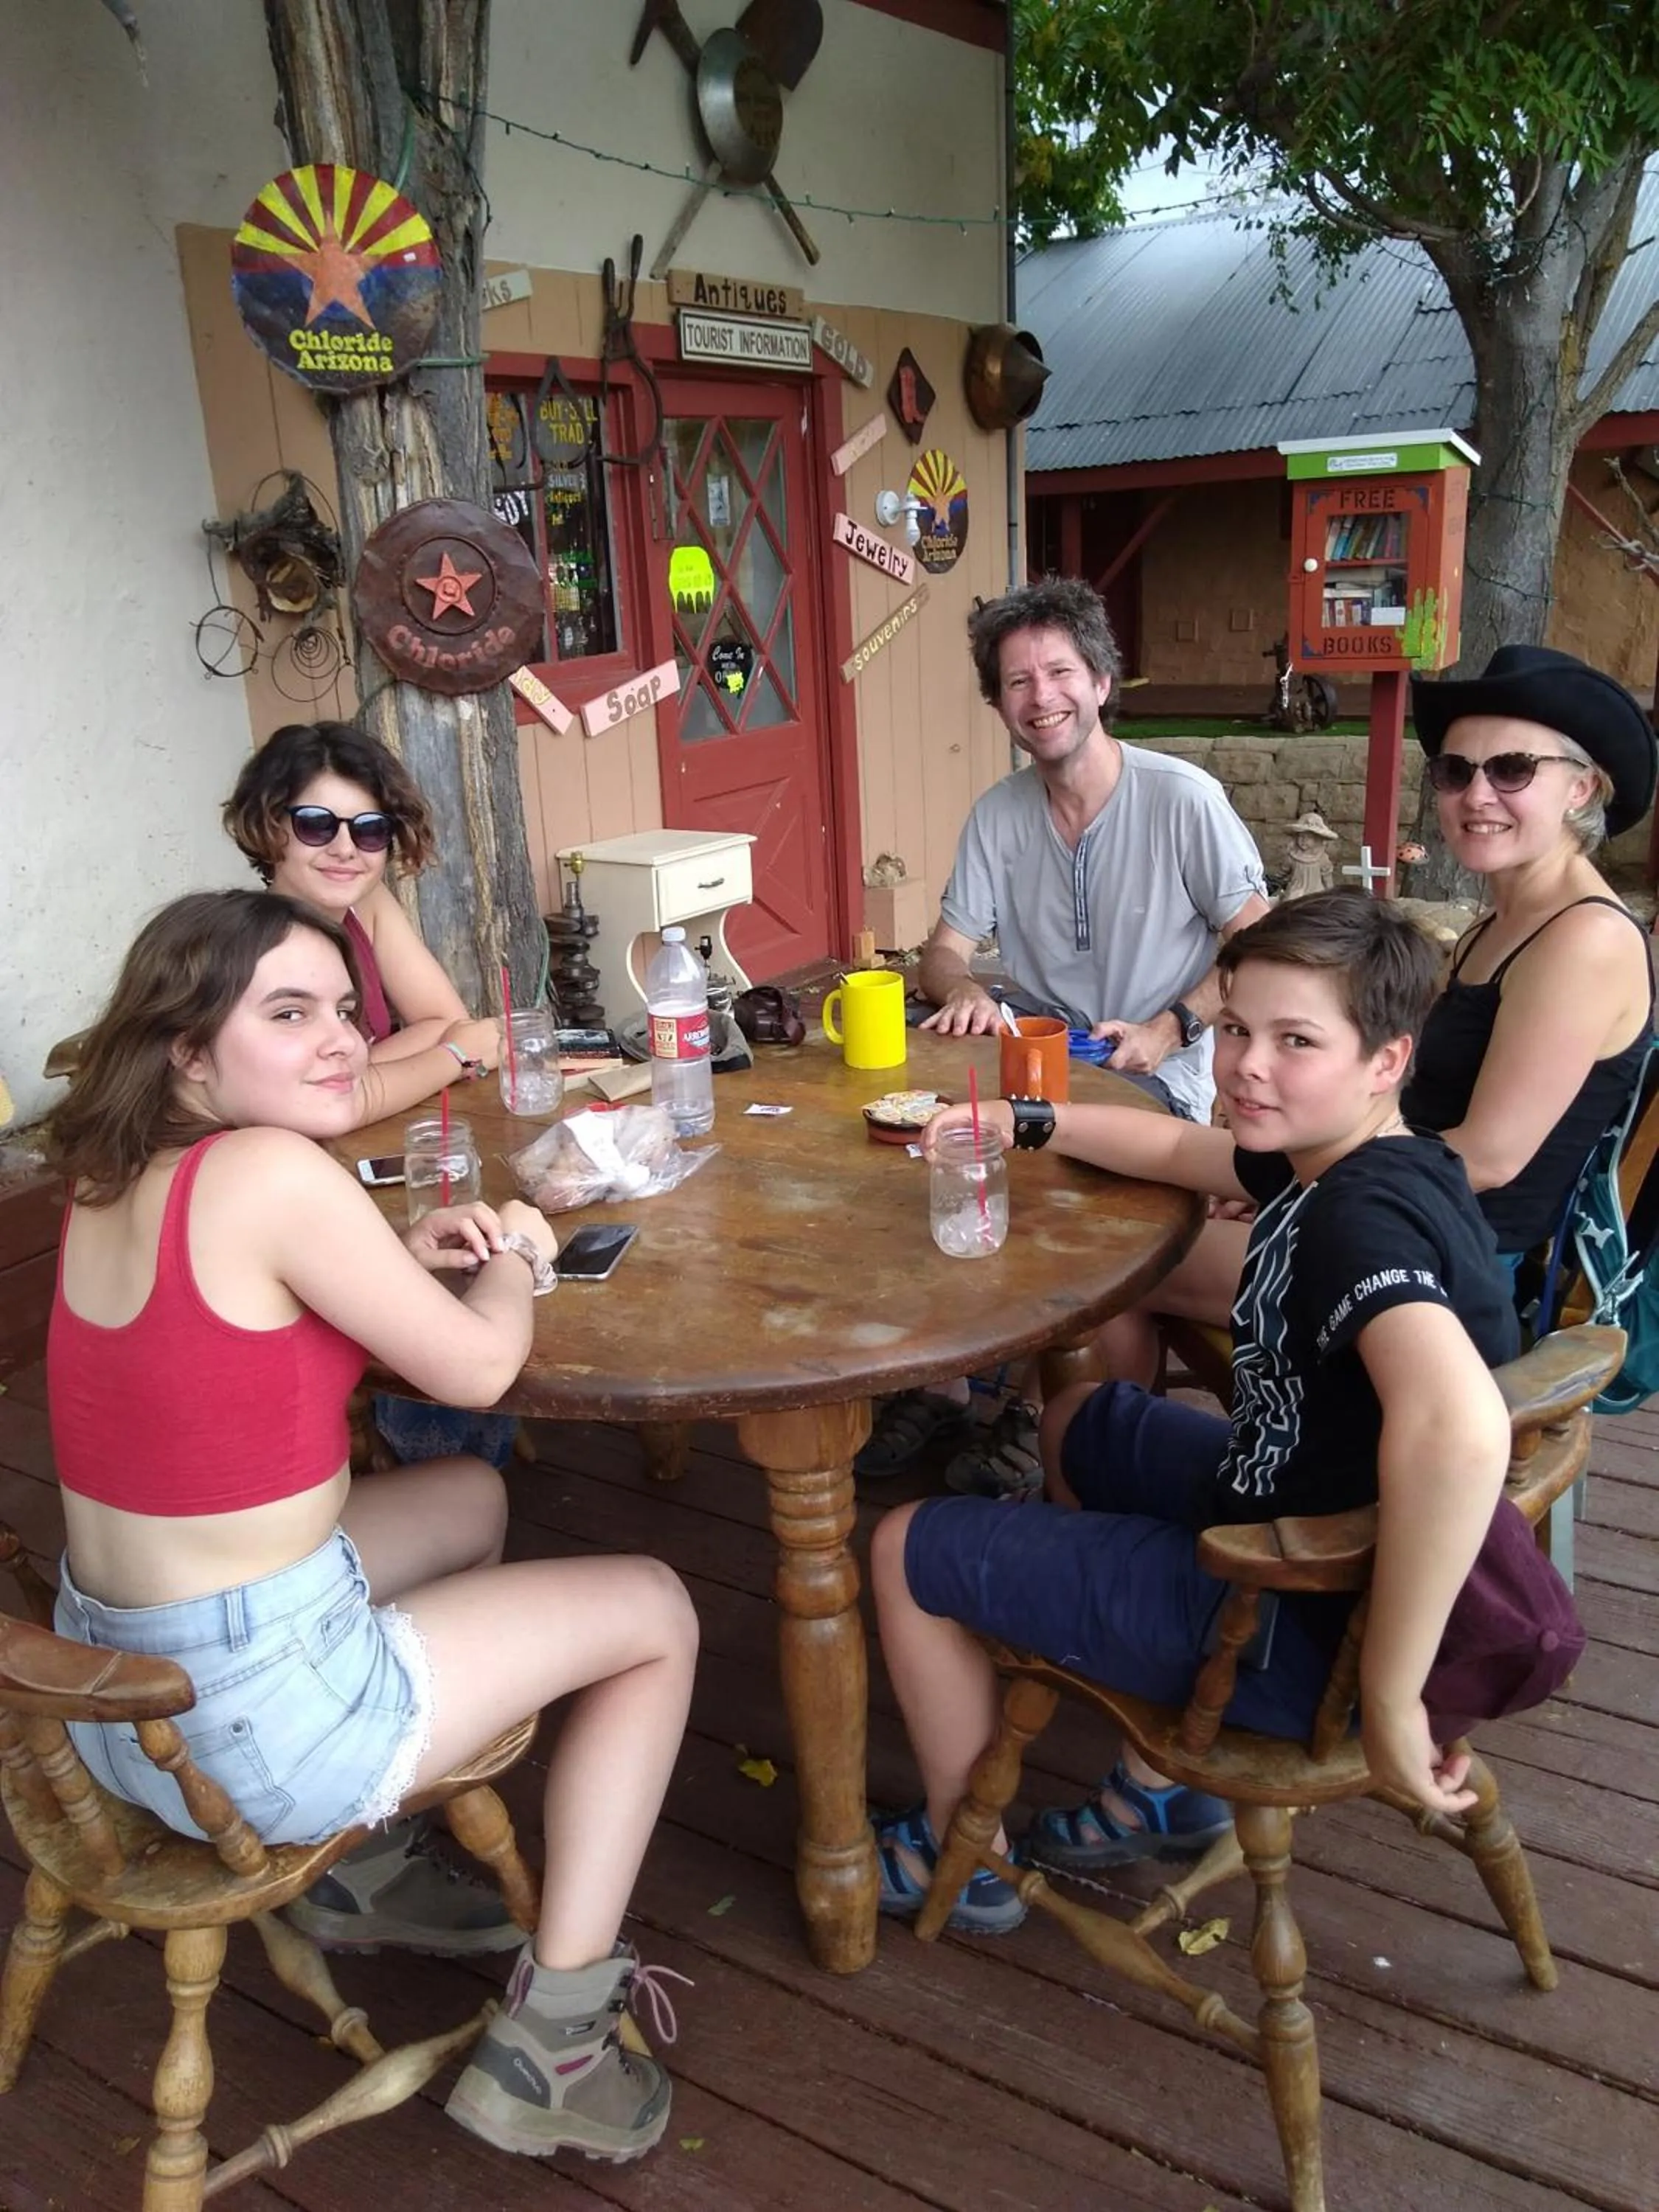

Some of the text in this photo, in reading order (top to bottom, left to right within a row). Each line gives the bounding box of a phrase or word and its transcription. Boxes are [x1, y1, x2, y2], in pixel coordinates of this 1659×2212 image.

[694, 273, 787, 313] Antiques
[288, 329, 394, 352] Chloride
[686, 323, 807, 360] TOURIST INFORMATION
[821, 324, 868, 380] GOLD
[296, 350, 394, 372] Arizona
[549, 422, 585, 445] TRAD
[1339, 489, 1396, 509] FREE
[845, 520, 909, 577] Jewelry
[1322, 636, 1392, 655] BOOKS
[606, 675, 661, 723] Soap
[1329, 1294, 1354, 1332] GAME
[1354, 1268, 1411, 1301] CHANGE
[1412, 1270, 1437, 1289] THE
